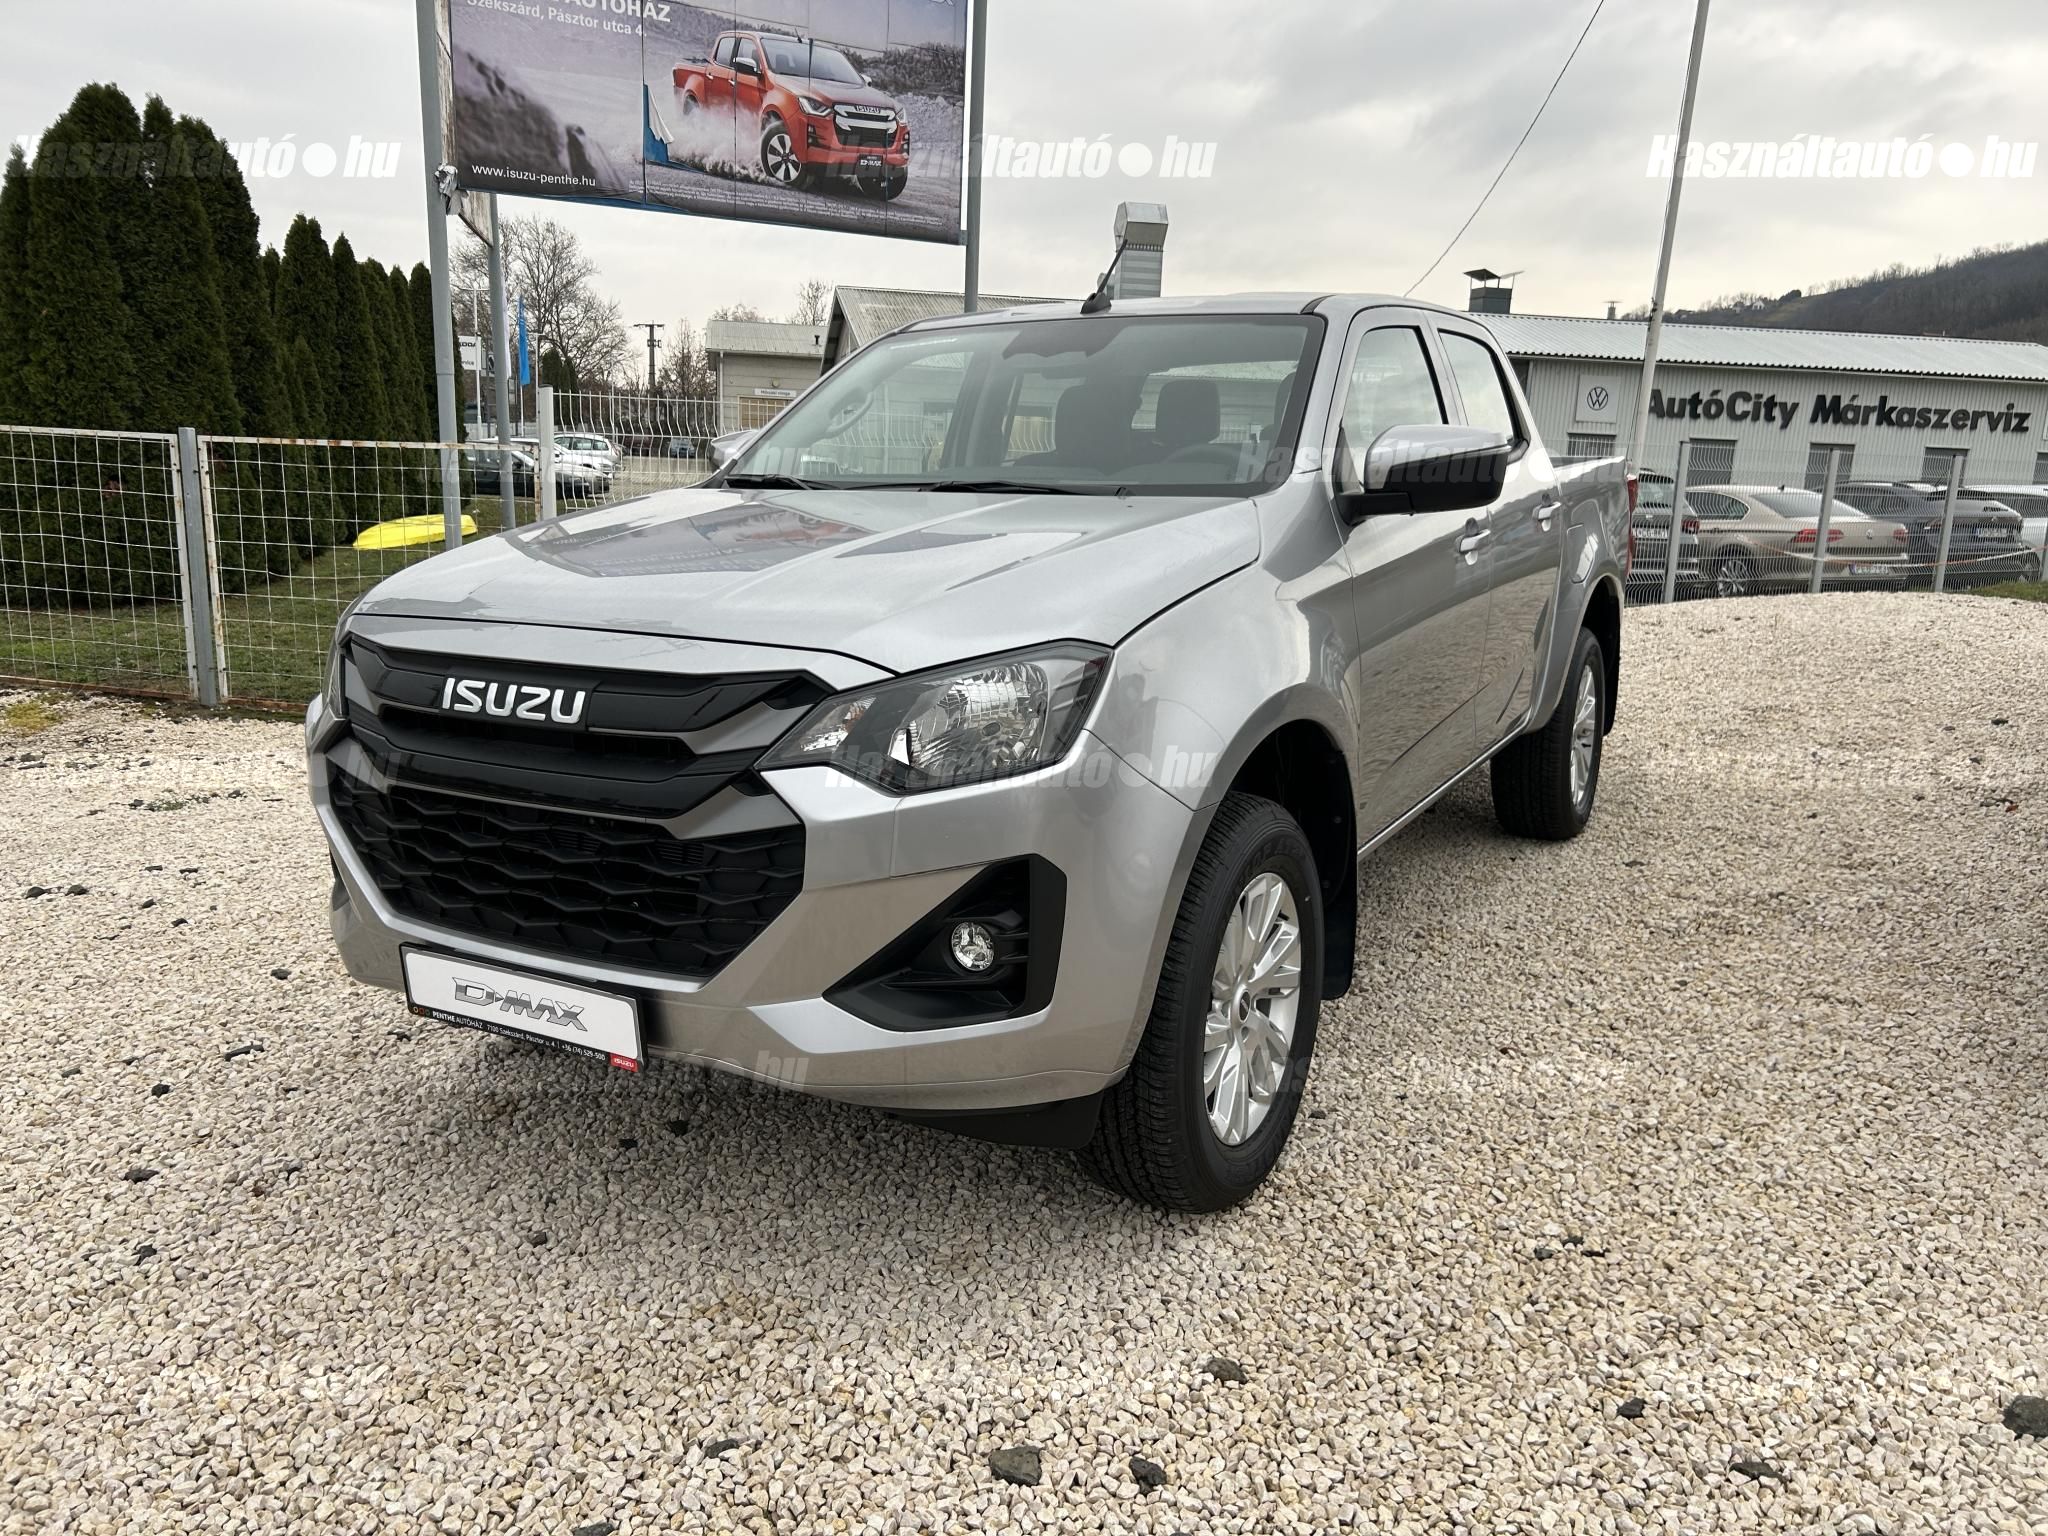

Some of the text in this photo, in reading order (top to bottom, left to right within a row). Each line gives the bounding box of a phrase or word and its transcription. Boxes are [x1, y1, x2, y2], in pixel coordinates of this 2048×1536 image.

[548, 7, 598, 28] Pásztor
[603, 20, 631, 34] utca
[856, 105, 880, 114] ISUZU
[472, 164, 596, 187] www.isuzu-penthe.hu
[1648, 389, 2032, 433] AutóCity Márkaszerviz
[442, 677, 586, 724] ISUZU
[452, 976, 588, 1031] D-MAX
[432, 1011, 455, 1022] PENTHE
[614, 1057, 634, 1068] ISUZU
